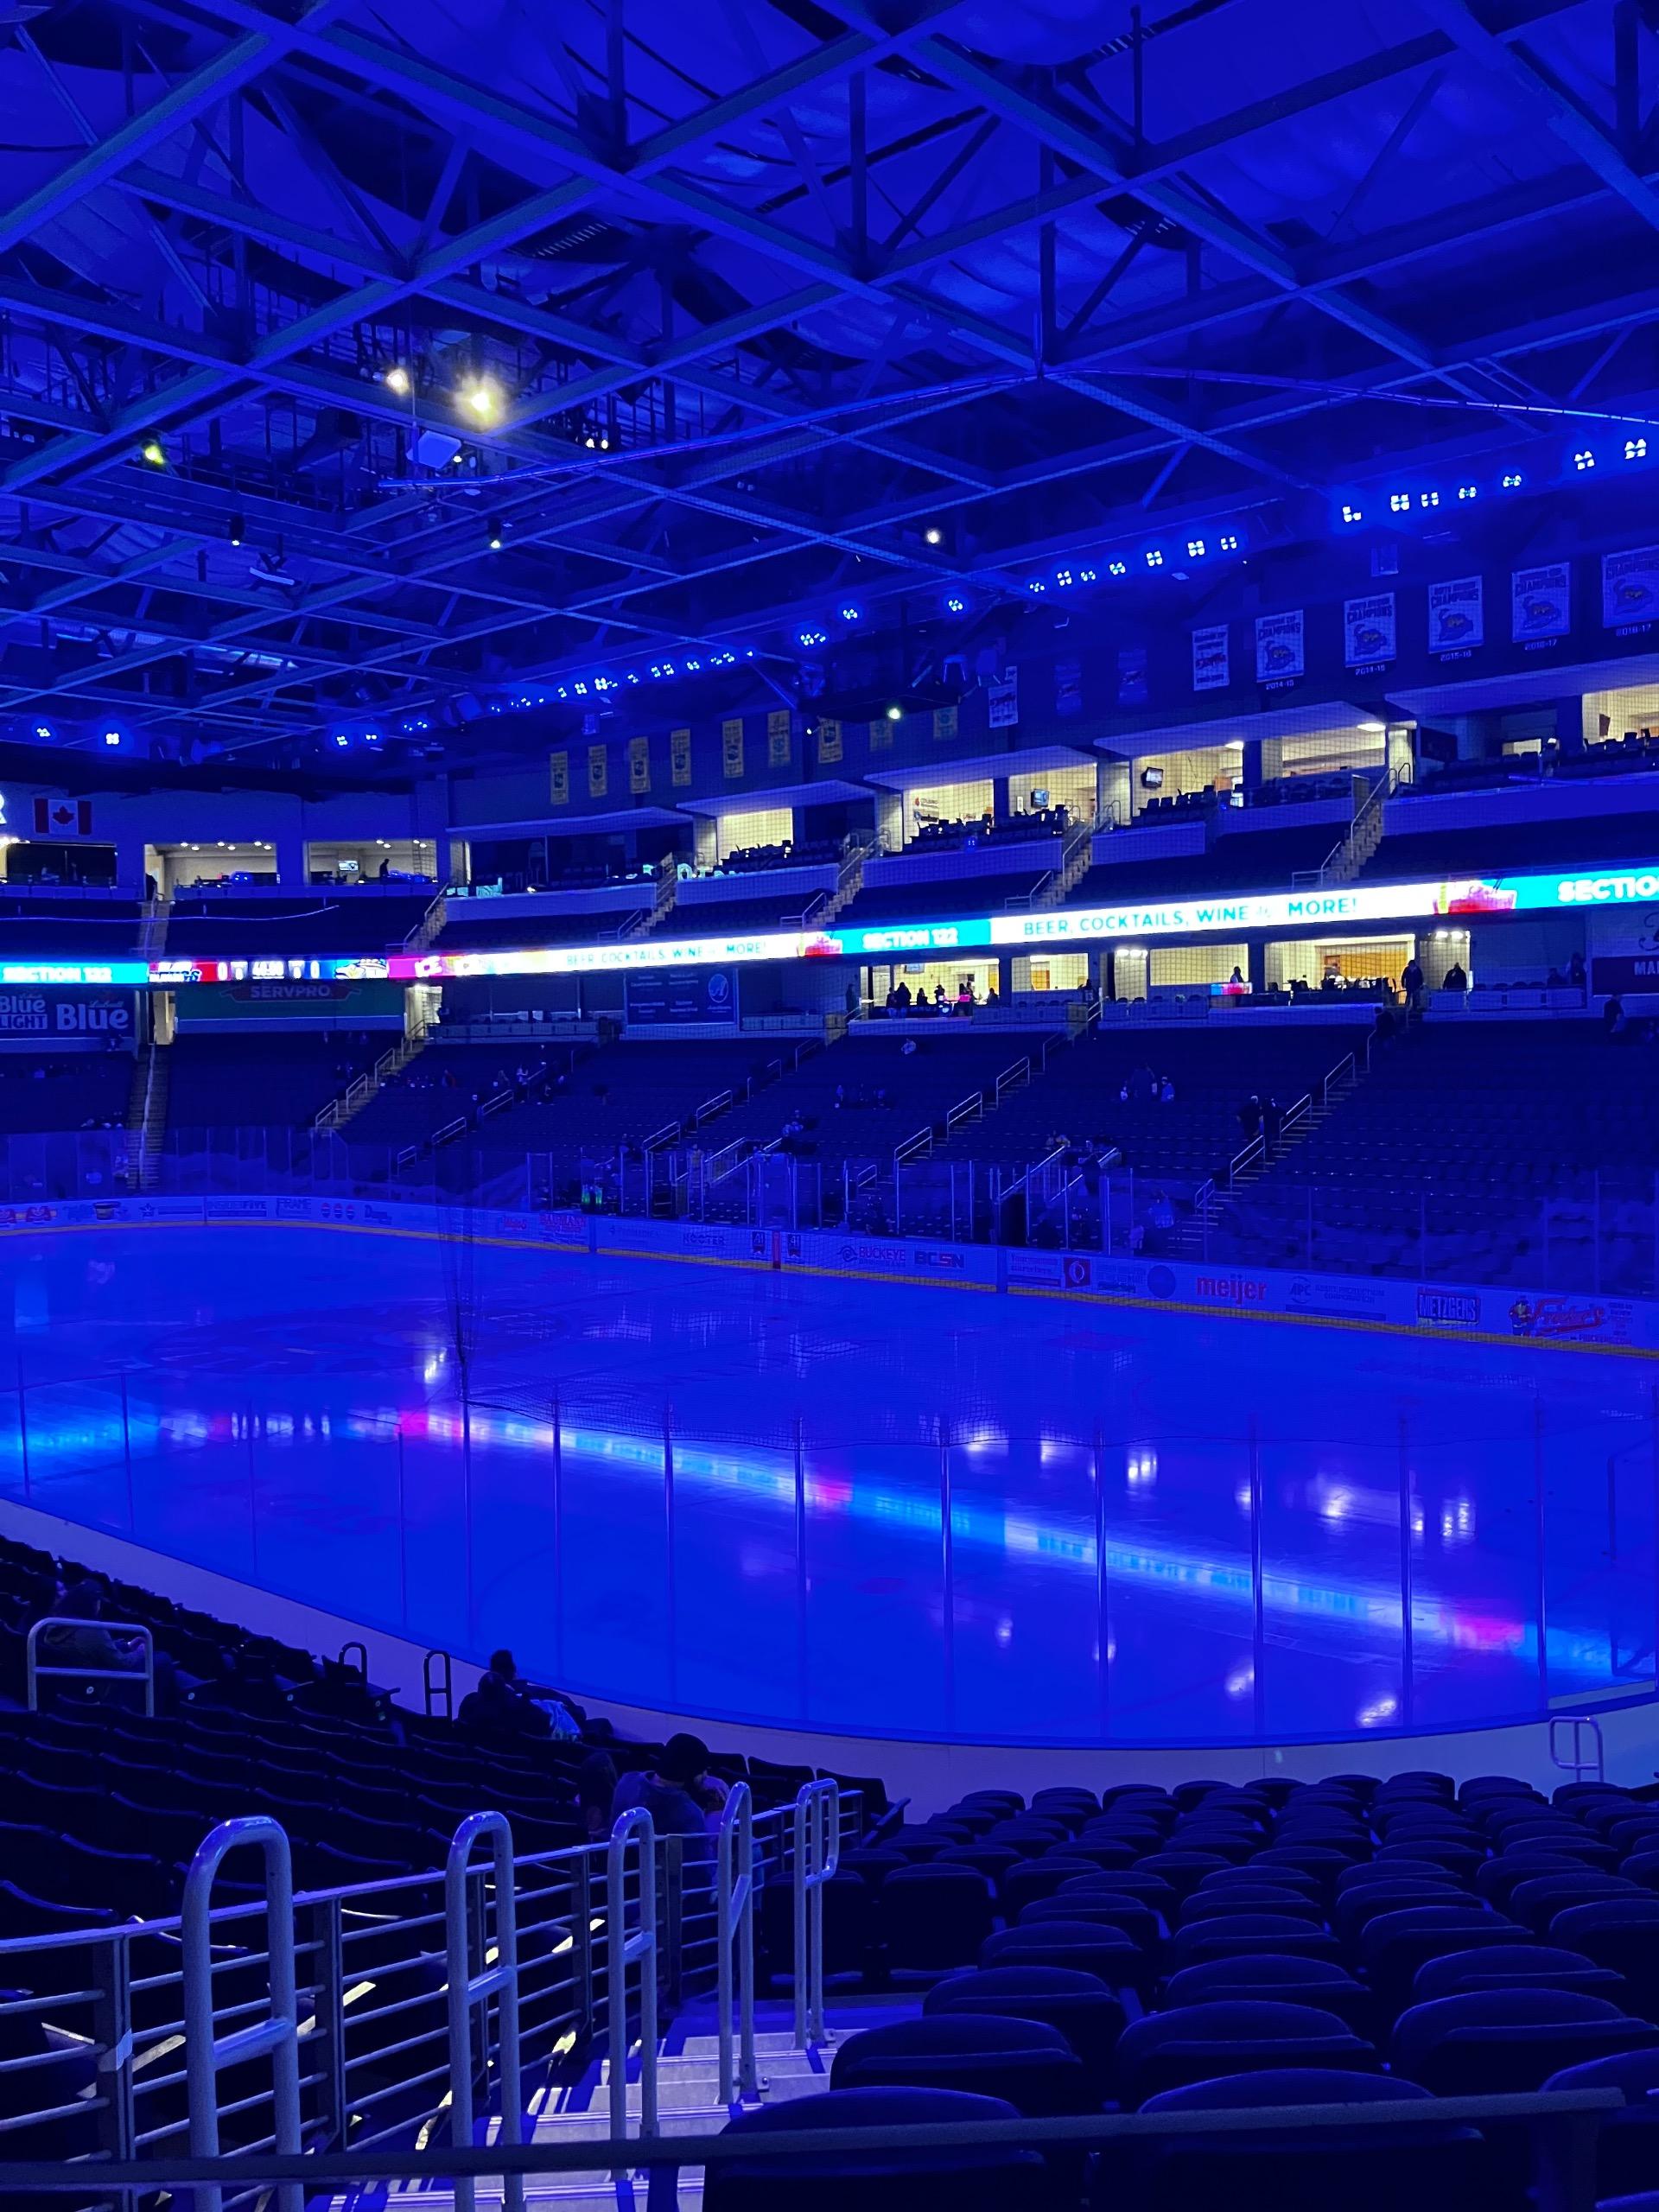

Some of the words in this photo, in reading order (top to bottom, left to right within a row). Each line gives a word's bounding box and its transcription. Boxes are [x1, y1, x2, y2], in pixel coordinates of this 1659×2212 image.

[1080, 910, 1189, 931] COCKTAILS,
[1196, 906, 1249, 923] WINE
[1287, 897, 1357, 916] MORE!
[862, 931, 929, 950] SECTION
[251, 984, 331, 999] SERVPRO
[0, 995, 46, 1014] Blue
[56, 1003, 129, 1030] Blue
[859, 1247, 906, 1261] BUCKEYE
[914, 1251, 964, 1268] BCSN
[1196, 1274, 1268, 1304] meijer
